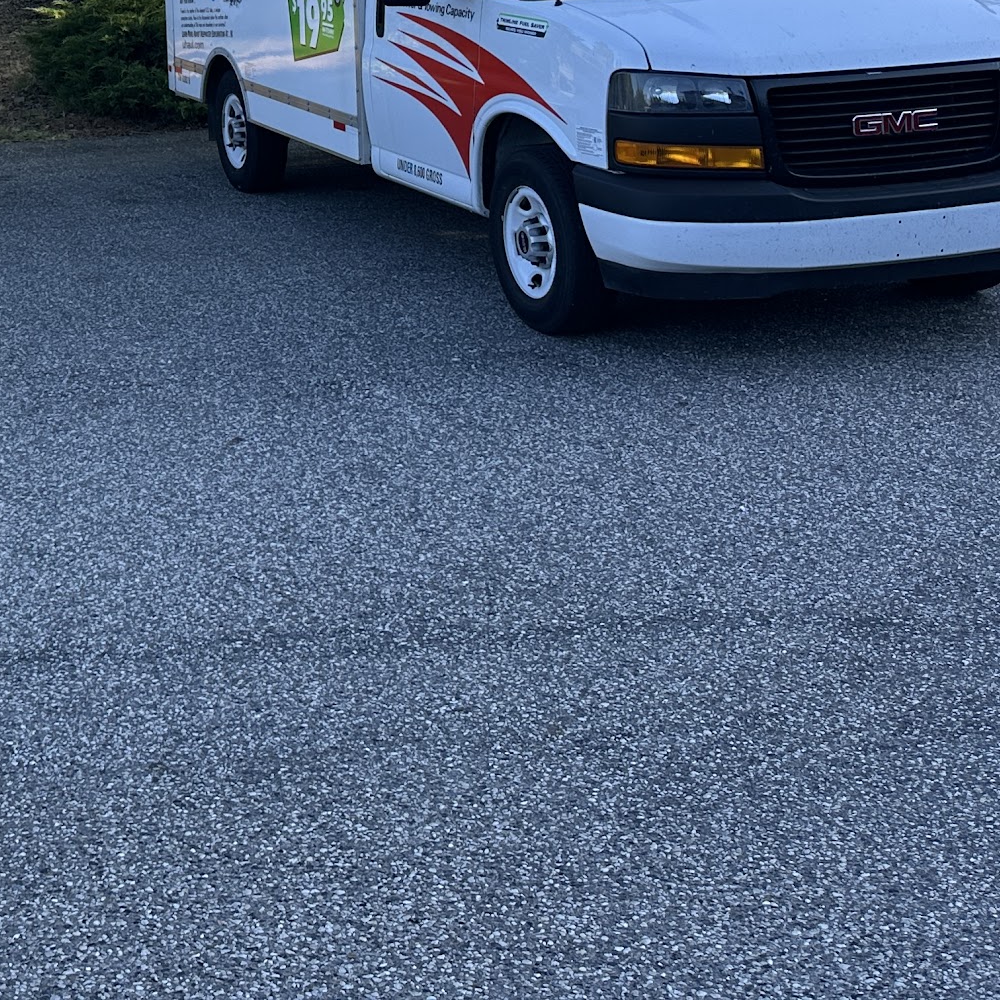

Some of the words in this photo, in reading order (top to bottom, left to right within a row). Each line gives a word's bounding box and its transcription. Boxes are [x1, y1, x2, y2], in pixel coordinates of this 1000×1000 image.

[445, 3, 475, 22] Capacity
[853, 108, 938, 136] GMC
[425, 167, 443, 186] GROSS
